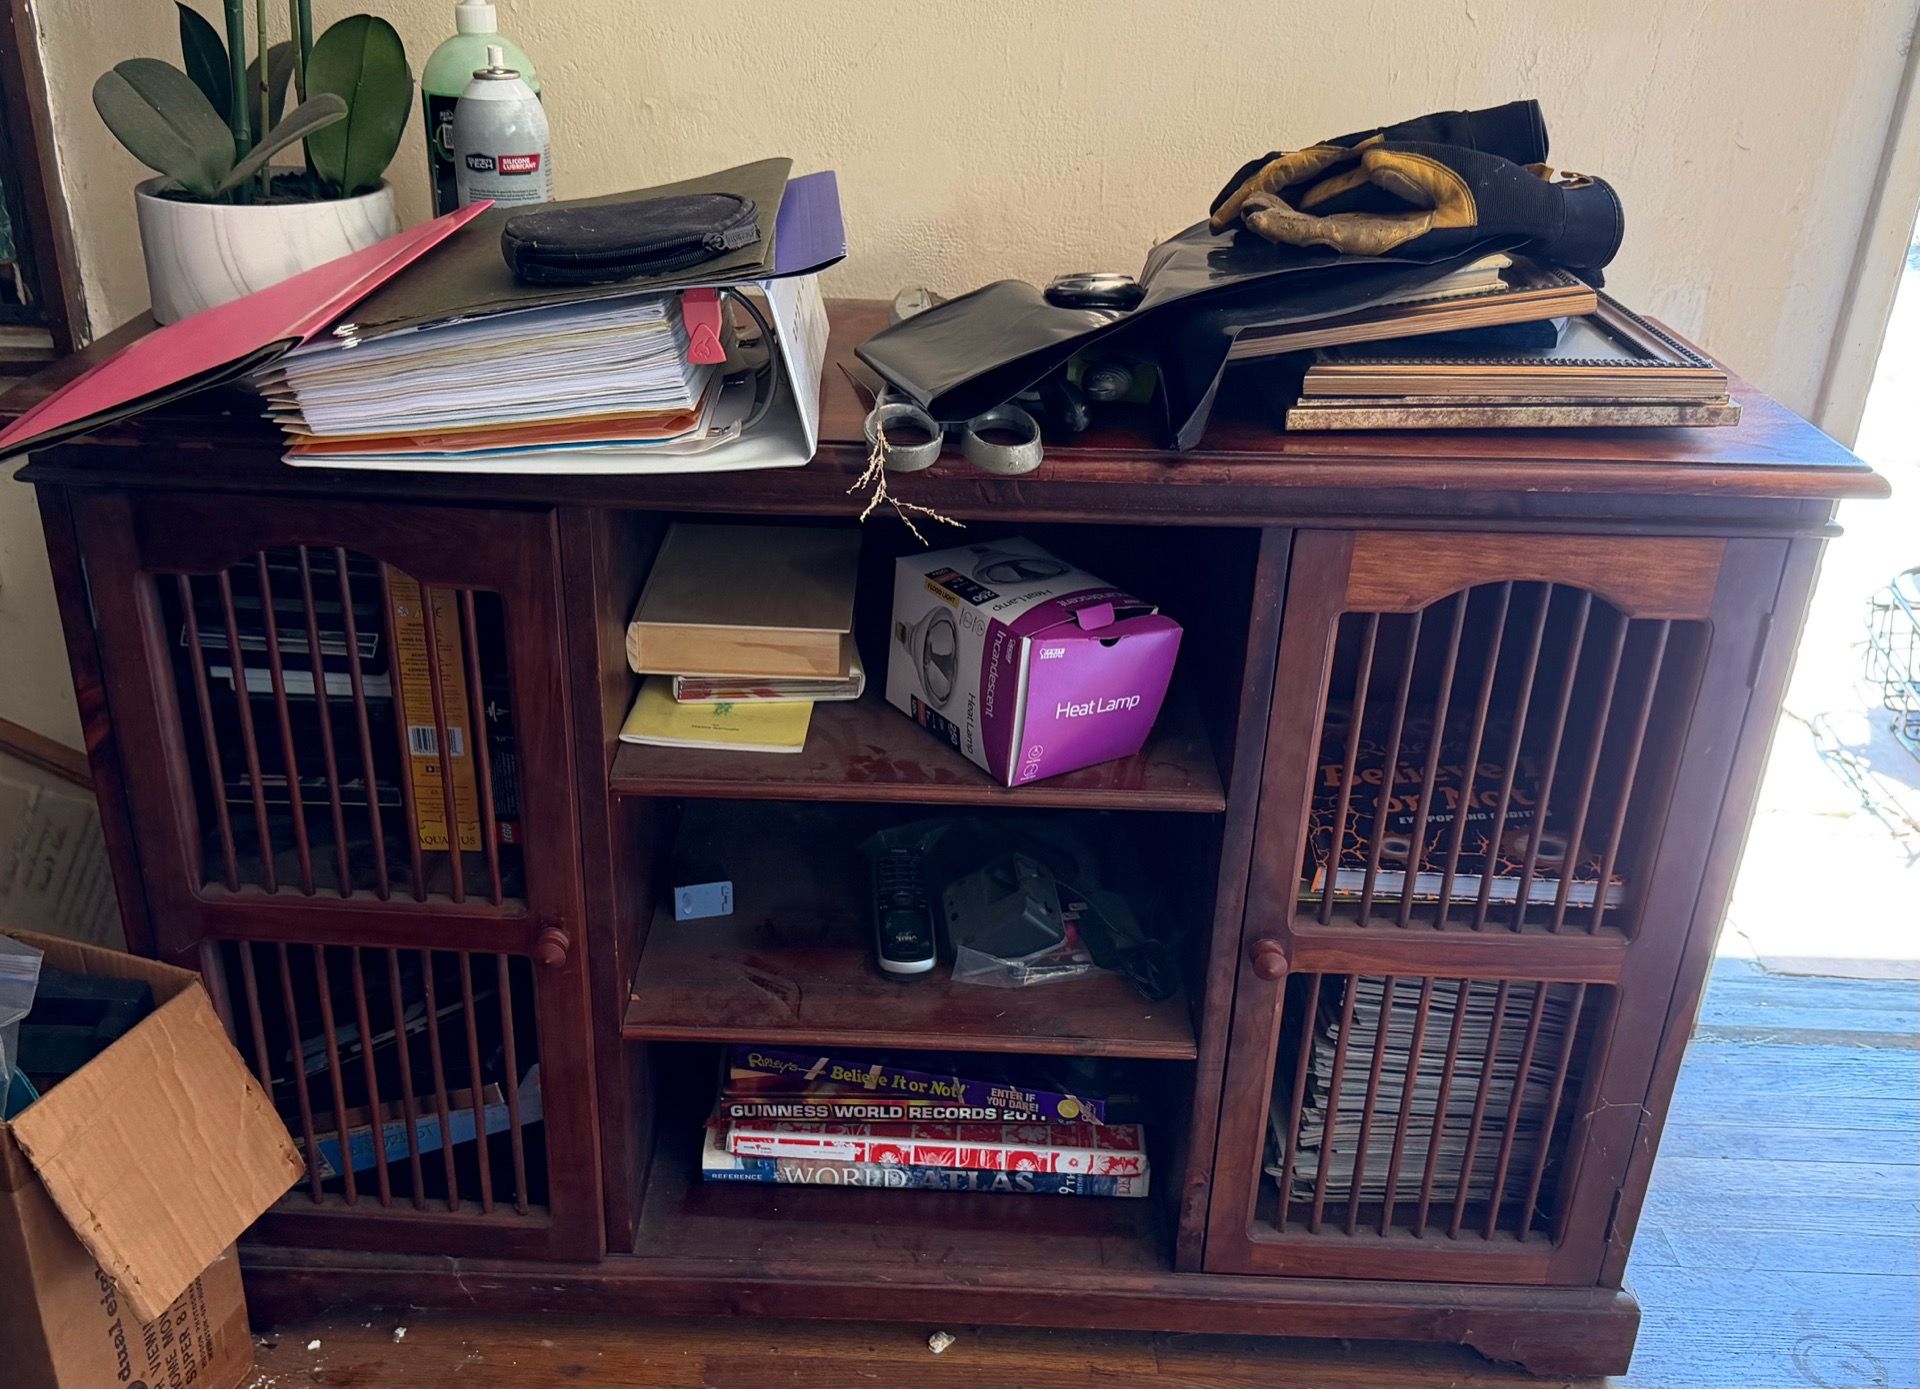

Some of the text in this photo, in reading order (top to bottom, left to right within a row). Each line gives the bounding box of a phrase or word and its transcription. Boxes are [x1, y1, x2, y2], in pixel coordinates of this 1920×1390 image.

[468, 162, 494, 170] TECH
[502, 162, 537, 170] LUBRICANT
[985, 630, 1007, 719] Incandescent
[1055, 695, 1141, 719] Heat Lamp
[966, 692, 976, 754] Heat Lamp
[418, 832, 477, 846] AQUAUS
[501, 823, 514, 844] LEGO
[830, 1065, 888, 1087] Believe
[891, 1074, 907, 1090] It
[909, 1081, 928, 1093] or
[986, 1096, 1040, 1113] YOU DARE!
[990, 1087, 1037, 1102] ENTER IF
[730, 1103, 830, 1118] GUINNESS
[833, 1105, 903, 1119] WORLD
[908, 1106, 997, 1121] RECORDS
[711, 1173, 763, 1181] REFERENCE
[783, 1165, 1035, 1193] WORLD ATLAS
[108, 1318, 131, 1382] dual
[179, 1327, 198, 1385] SUPER
